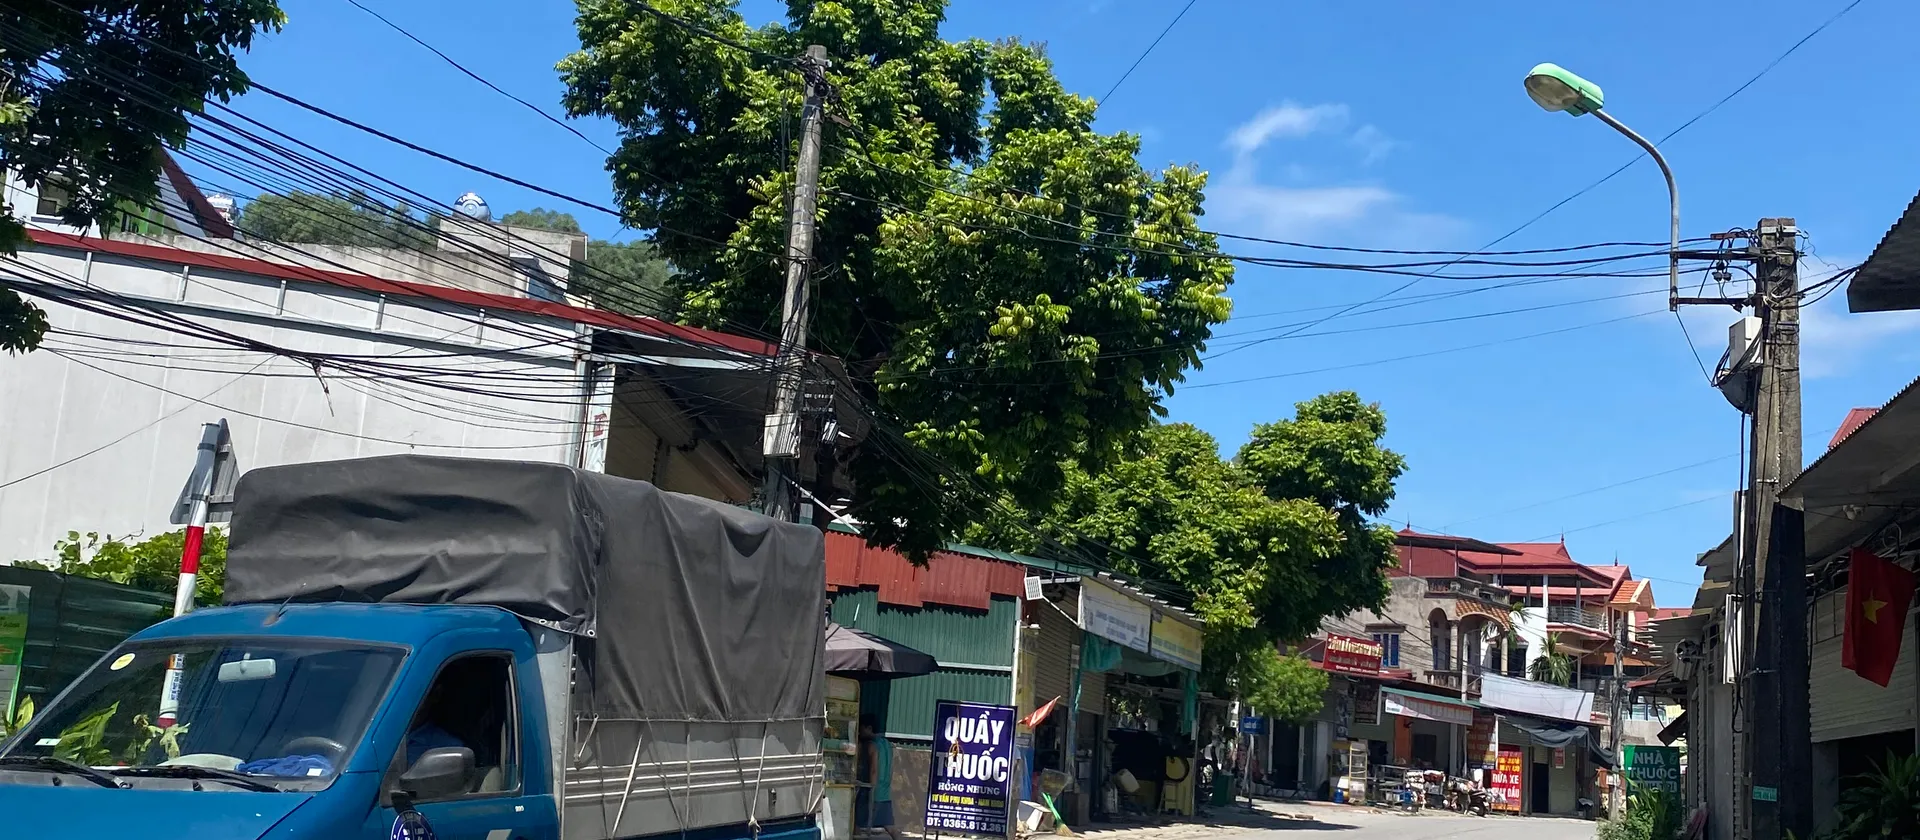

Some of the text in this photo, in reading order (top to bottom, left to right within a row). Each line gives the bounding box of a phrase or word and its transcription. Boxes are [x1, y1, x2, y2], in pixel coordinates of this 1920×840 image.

[944, 711, 1004, 745] QUẦY
[1634, 750, 1664, 764] NHÀ
[935, 747, 1008, 782] THUỐC
[1628, 764, 1677, 779] THUỐC
[1509, 774, 1519, 784] XE
[966, 784, 1000, 795] NHUNG
